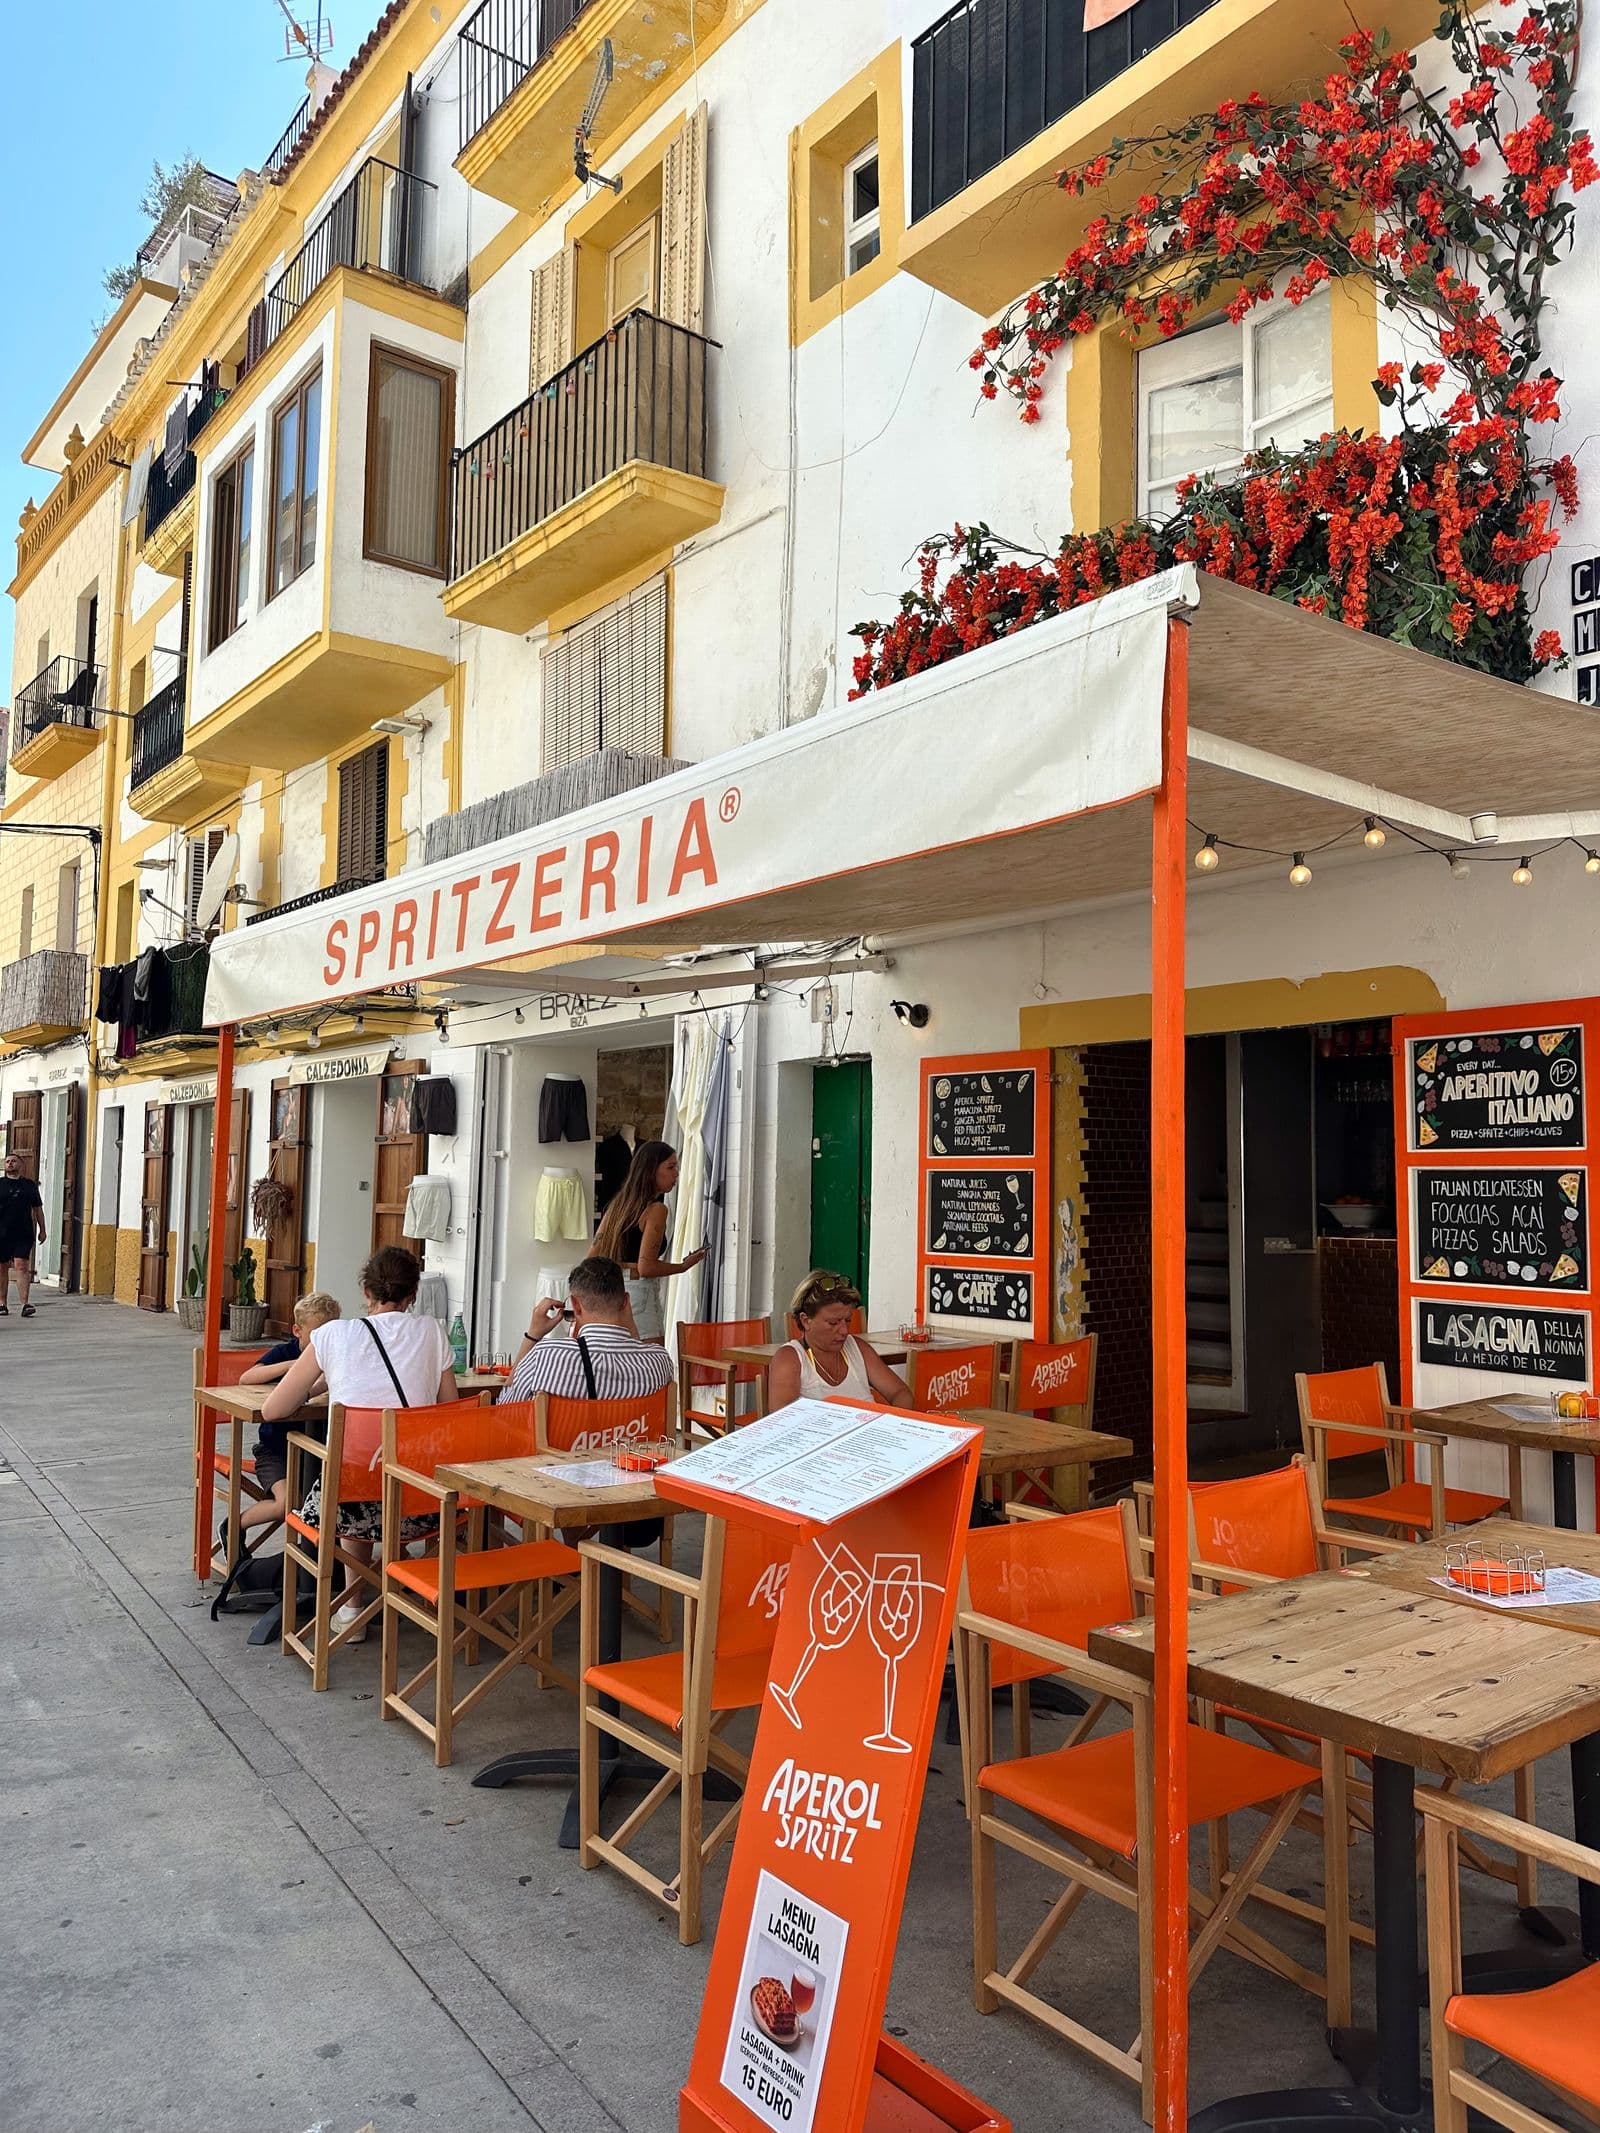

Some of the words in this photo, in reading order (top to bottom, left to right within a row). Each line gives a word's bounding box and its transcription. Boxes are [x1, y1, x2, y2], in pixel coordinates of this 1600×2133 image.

[305, 1056, 369, 1082] CALZEDONIA
[1456, 1061, 1478, 1072] EVERY
[169, 1082, 210, 1102] CALZEDONIA
[1441, 1069, 1539, 1102] APERITIVO
[954, 1096, 974, 1106] APEROL
[977, 1095, 994, 1105] SPRITZ
[984, 1104, 1002, 1113] SPRITZ
[1488, 1093, 1574, 1125] ITALIANO
[954, 1116, 975, 1125] GINGER
[976, 1115, 996, 1124] SPRITZ
[954, 1125, 965, 1134] RED
[966, 1125, 985, 1134] FRUITS
[987, 1123, 1006, 1134] SPRITZ
[954, 1136, 970, 1146] HUGO
[971, 1136, 991, 1146] SPRITZ
[941, 1179, 967, 1189] NATURAL
[969, 1179, 987, 1189] JUICES
[1430, 1180, 1470, 1197] ITALIAN
[1473, 1179, 1543, 1198] DELICATESSEN
[957, 1190, 981, 1199] SANGRIA
[982, 1190, 1000, 1200] SPRITZ
[941, 1200, 967, 1210] NATURAL
[968, 1201, 1000, 1212] LEMONADES
[1431, 1202, 1500, 1226] FOCACCIAS
[1511, 1202, 1544, 1229] AÇAÍ
[942, 1221, 971, 1232] ARTISANAL
[972, 1222, 989, 1233] BEERS
[947, 1211, 976, 1222] SIGNATURE
[976, 1212, 1005, 1224] COCKTAILS
[1432, 1227, 1479, 1251] PIZZAS
[1492, 1230, 1548, 1256] SALADS
[976, 1306, 990, 1314] TOWN
[1427, 1313, 1540, 1355] LASAGNA
[1543, 1320, 1583, 1339] DELLA
[1544, 1340, 1584, 1357] NONNA
[1031, 1353, 1077, 1388] APEROL
[1455, 1351, 1468, 1363] LA
[1473, 1352, 1509, 1367] MEJOR
[1512, 1355, 1529, 1369] DE
[1534, 1358, 1557, 1372] IBZ
[927, 1362, 976, 1401] APEROL
[570, 1413, 649, 1452] APEROL
[761, 1758, 882, 1830] APEROL
[781, 1898, 816, 1935] MENU
[767, 1914, 820, 1965] LASAGNA
[741, 2027, 773, 2063] LASAGNA
[780, 2059, 805, 2088] DRINK
[763, 2062, 784, 2085] REFRESCO
[742, 2064, 756, 2090] 15
[757, 2076, 793, 2121] EURO
